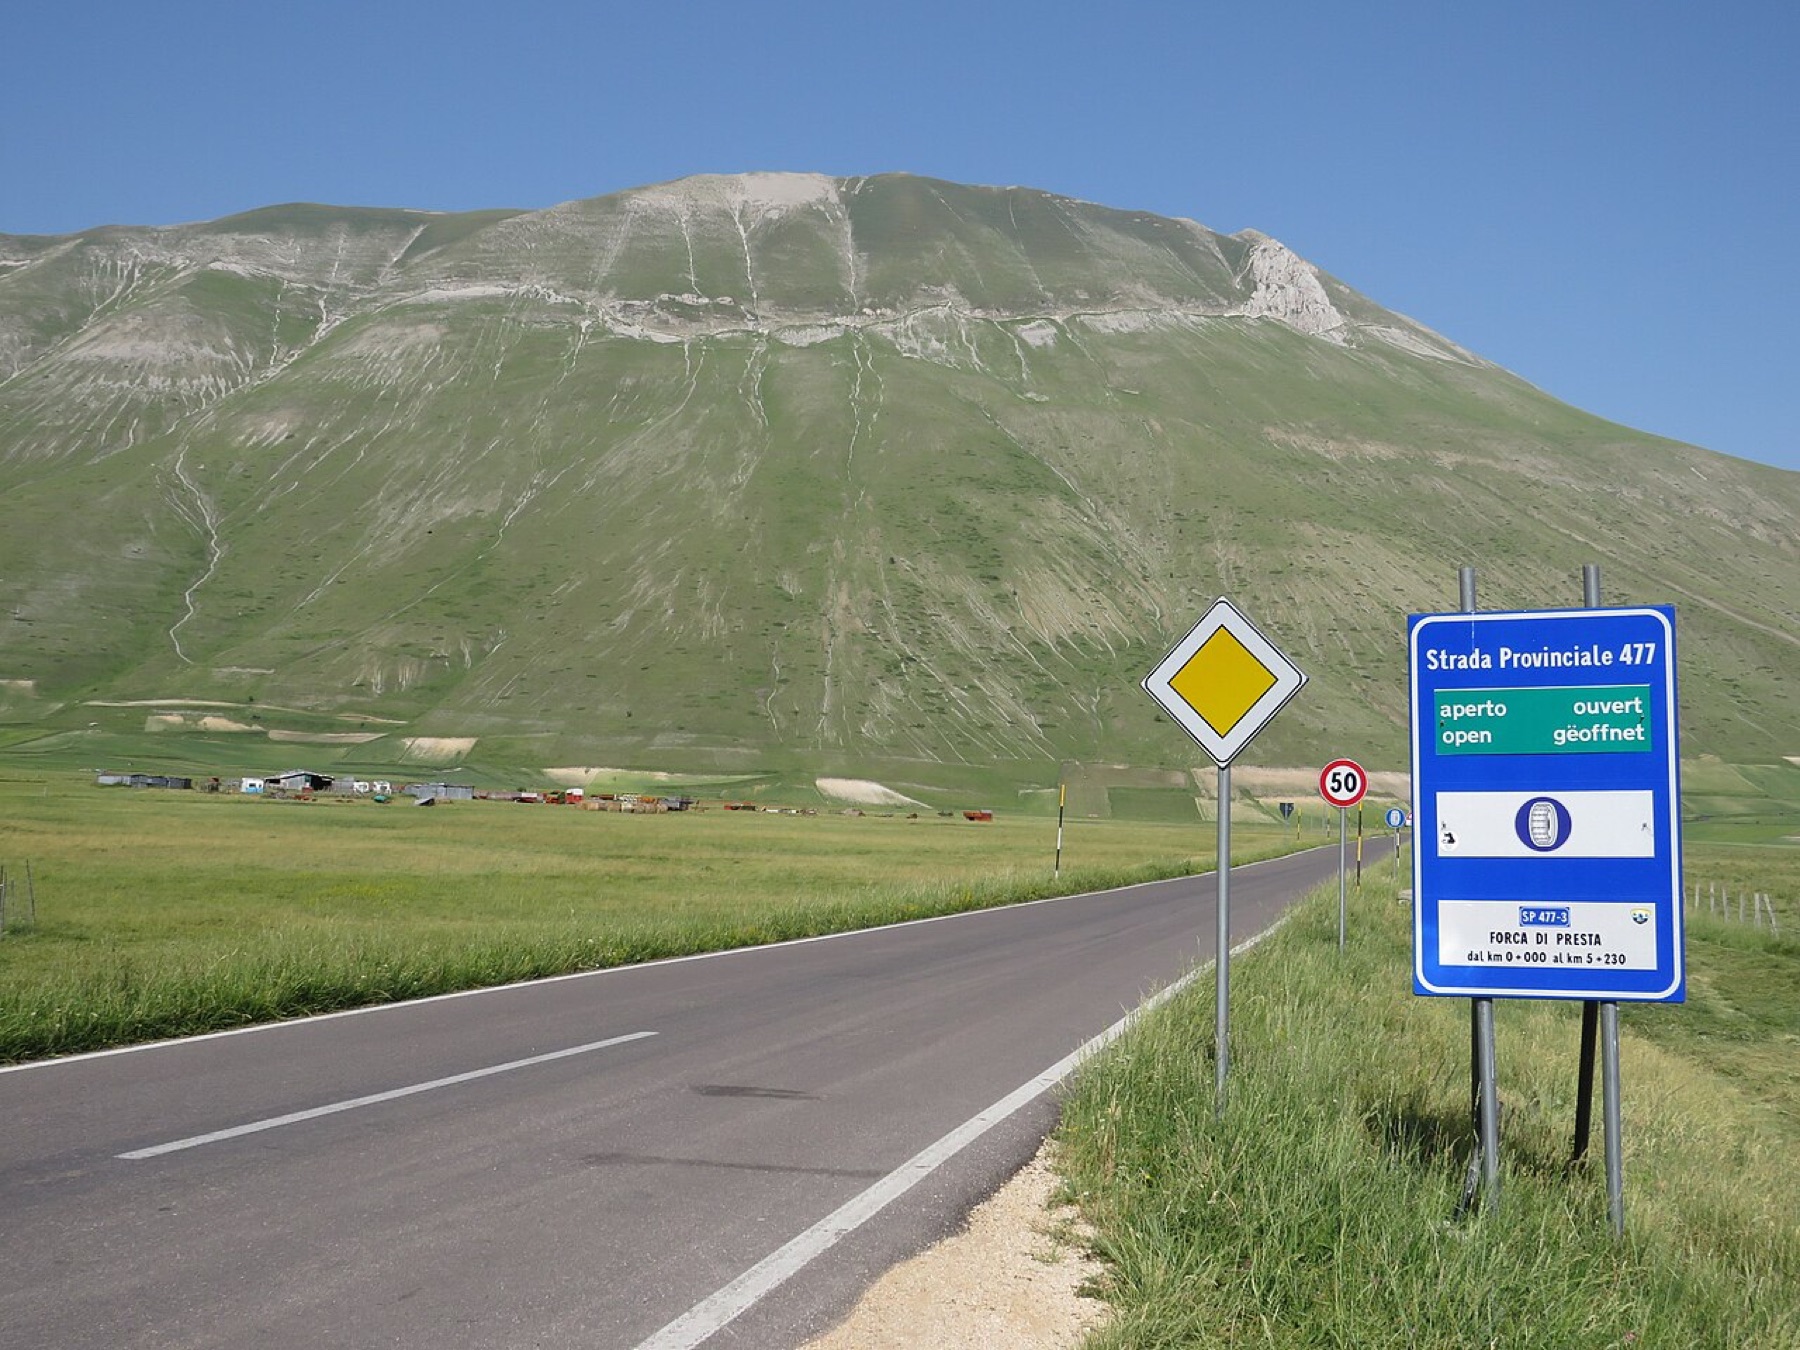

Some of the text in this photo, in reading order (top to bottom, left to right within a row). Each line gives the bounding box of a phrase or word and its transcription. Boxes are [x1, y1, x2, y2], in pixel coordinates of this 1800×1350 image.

[1426, 643, 1656, 670] Strada Provinciale 477
[1440, 700, 1507, 720] aperto
[1573, 697, 1643, 715] ouvert
[1442, 729, 1492, 747] open
[1553, 723, 1645, 745] gëoffnet
[1330, 772, 1357, 793] 50
[1522, 911, 1568, 923] SP 477-3
[1490, 931, 1602, 946] FORCA DI PRESTA
[1467, 951, 1484, 962] dal
[1487, 951, 1503, 962] km
[1553, 952, 1563, 963] al
[1567, 953, 1582, 964] km
